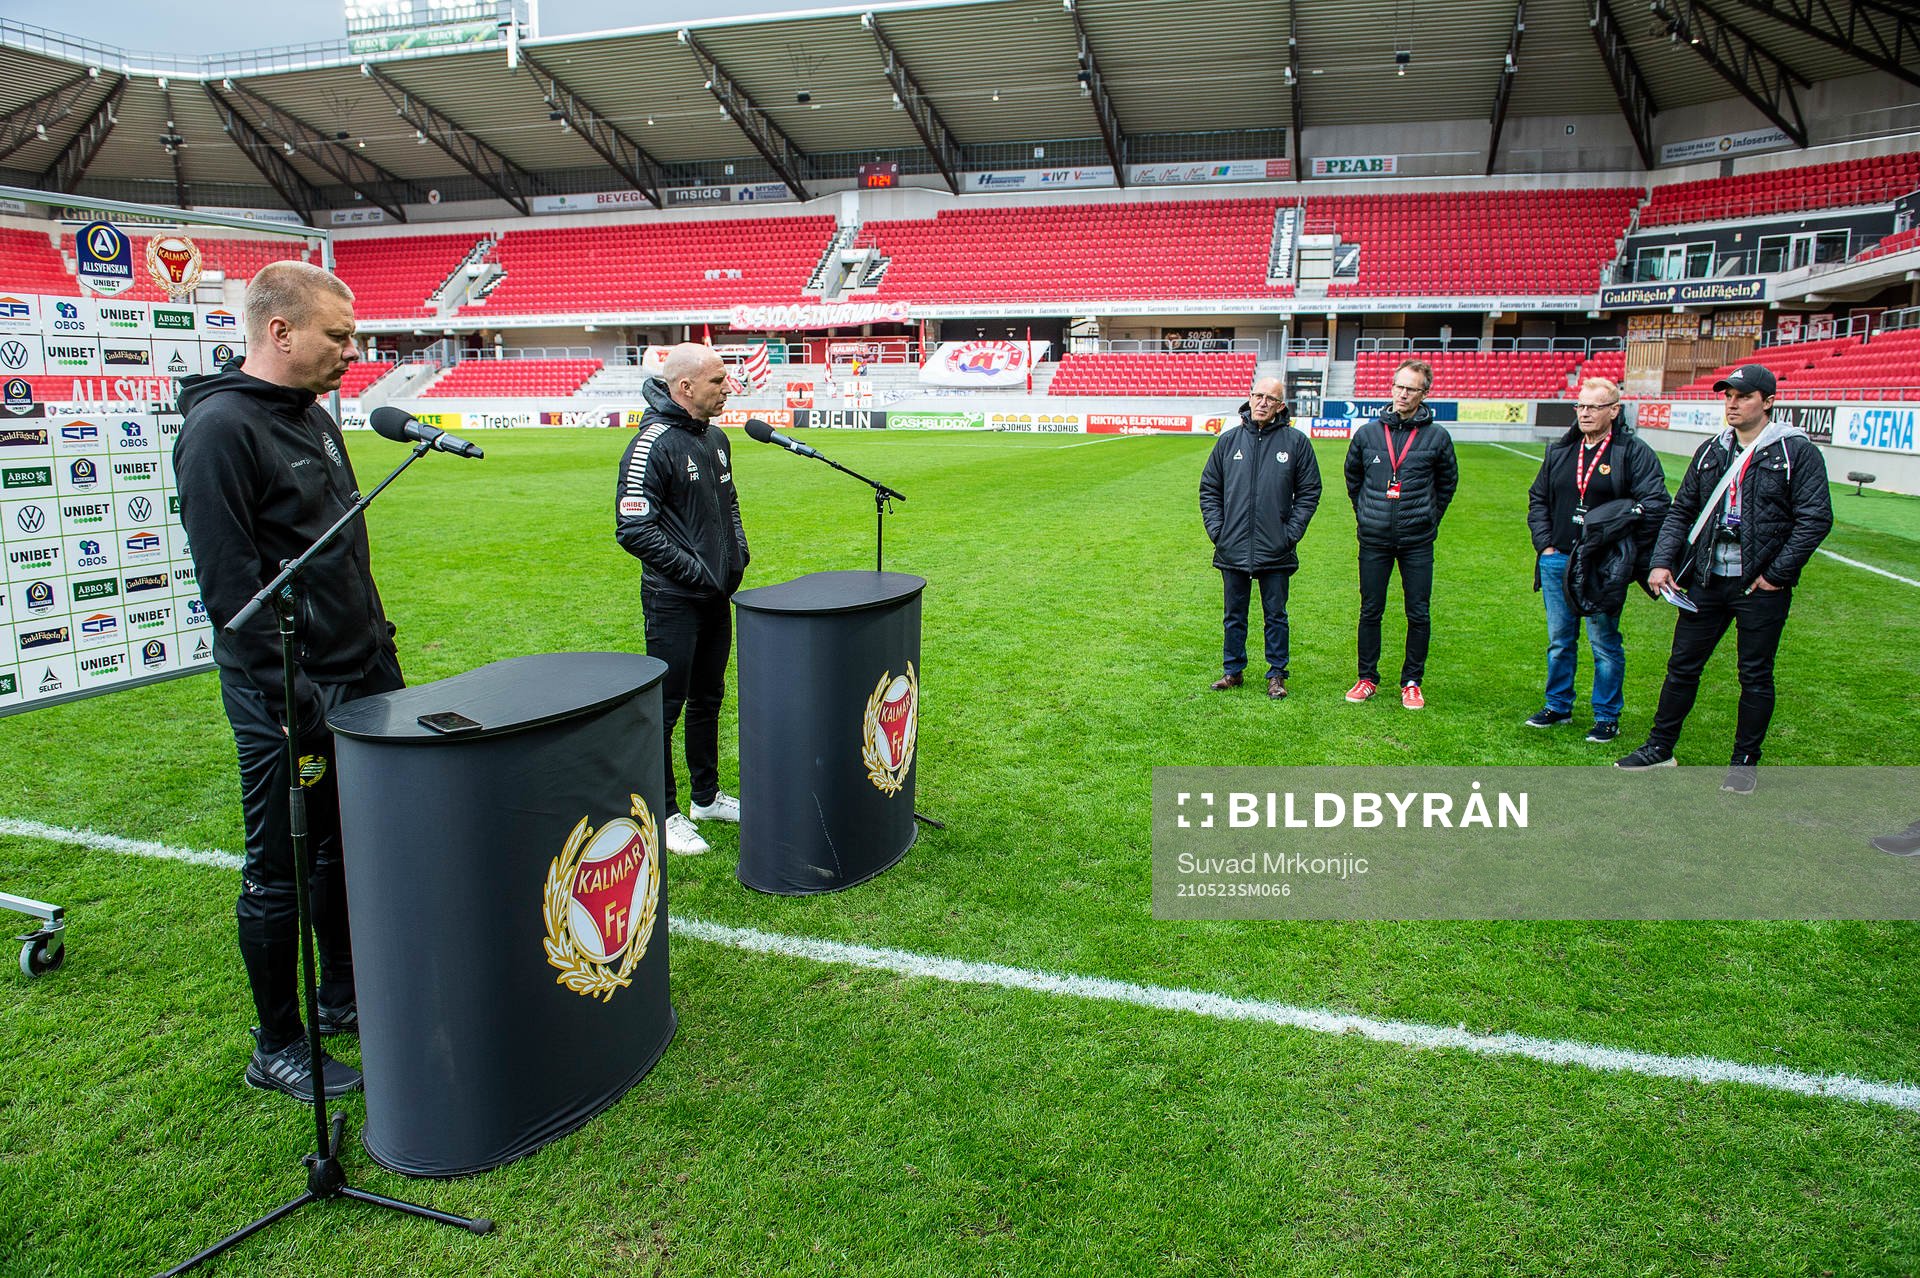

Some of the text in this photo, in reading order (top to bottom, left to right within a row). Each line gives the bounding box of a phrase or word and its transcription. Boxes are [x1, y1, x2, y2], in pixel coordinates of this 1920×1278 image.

[1325, 158, 1383, 173] PEAB
[1051, 171, 1070, 181] IVT
[676, 188, 721, 200] inside
[157, 249, 191, 261] KALMAR
[83, 262, 128, 275] ALLSVENSKAN
[93, 279, 120, 287] UNIBET
[100, 308, 145, 321] UNIBET
[54, 321, 86, 330] OBOS
[1187, 331, 1213, 340] 50/50
[47, 346, 95, 358] UNIBET
[342, 415, 366, 429] rizy
[416, 414, 442, 424] YLTE
[809, 410, 871, 428] BJELIN
[891, 417, 970, 429] CASHBUDDY
[1090, 415, 1187, 427] RIKTIGA ELEKTRIKER
[1313, 419, 1349, 427] SPORT
[1799, 408, 1833, 433] ZIWA
[1312, 429, 1348, 437] VISION
[1861, 410, 1914, 449] STENA
[120, 438, 148, 447] OBOS
[114, 462, 158, 474] UNIBET
[690, 472, 699, 481] HR
[63, 503, 110, 518] UNIBET
[622, 501, 647, 510] UNIBET
[10, 547, 59, 563] UNIBET
[78, 556, 107, 567] OBOS
[129, 608, 171, 624] UNIBET
[81, 653, 126, 671] UNIBET
[193, 651, 212, 661] SELECT
[39, 682, 62, 693] SELECT
[881, 695, 911, 723] KALMAR
[577, 842, 644, 894] KALMAR
